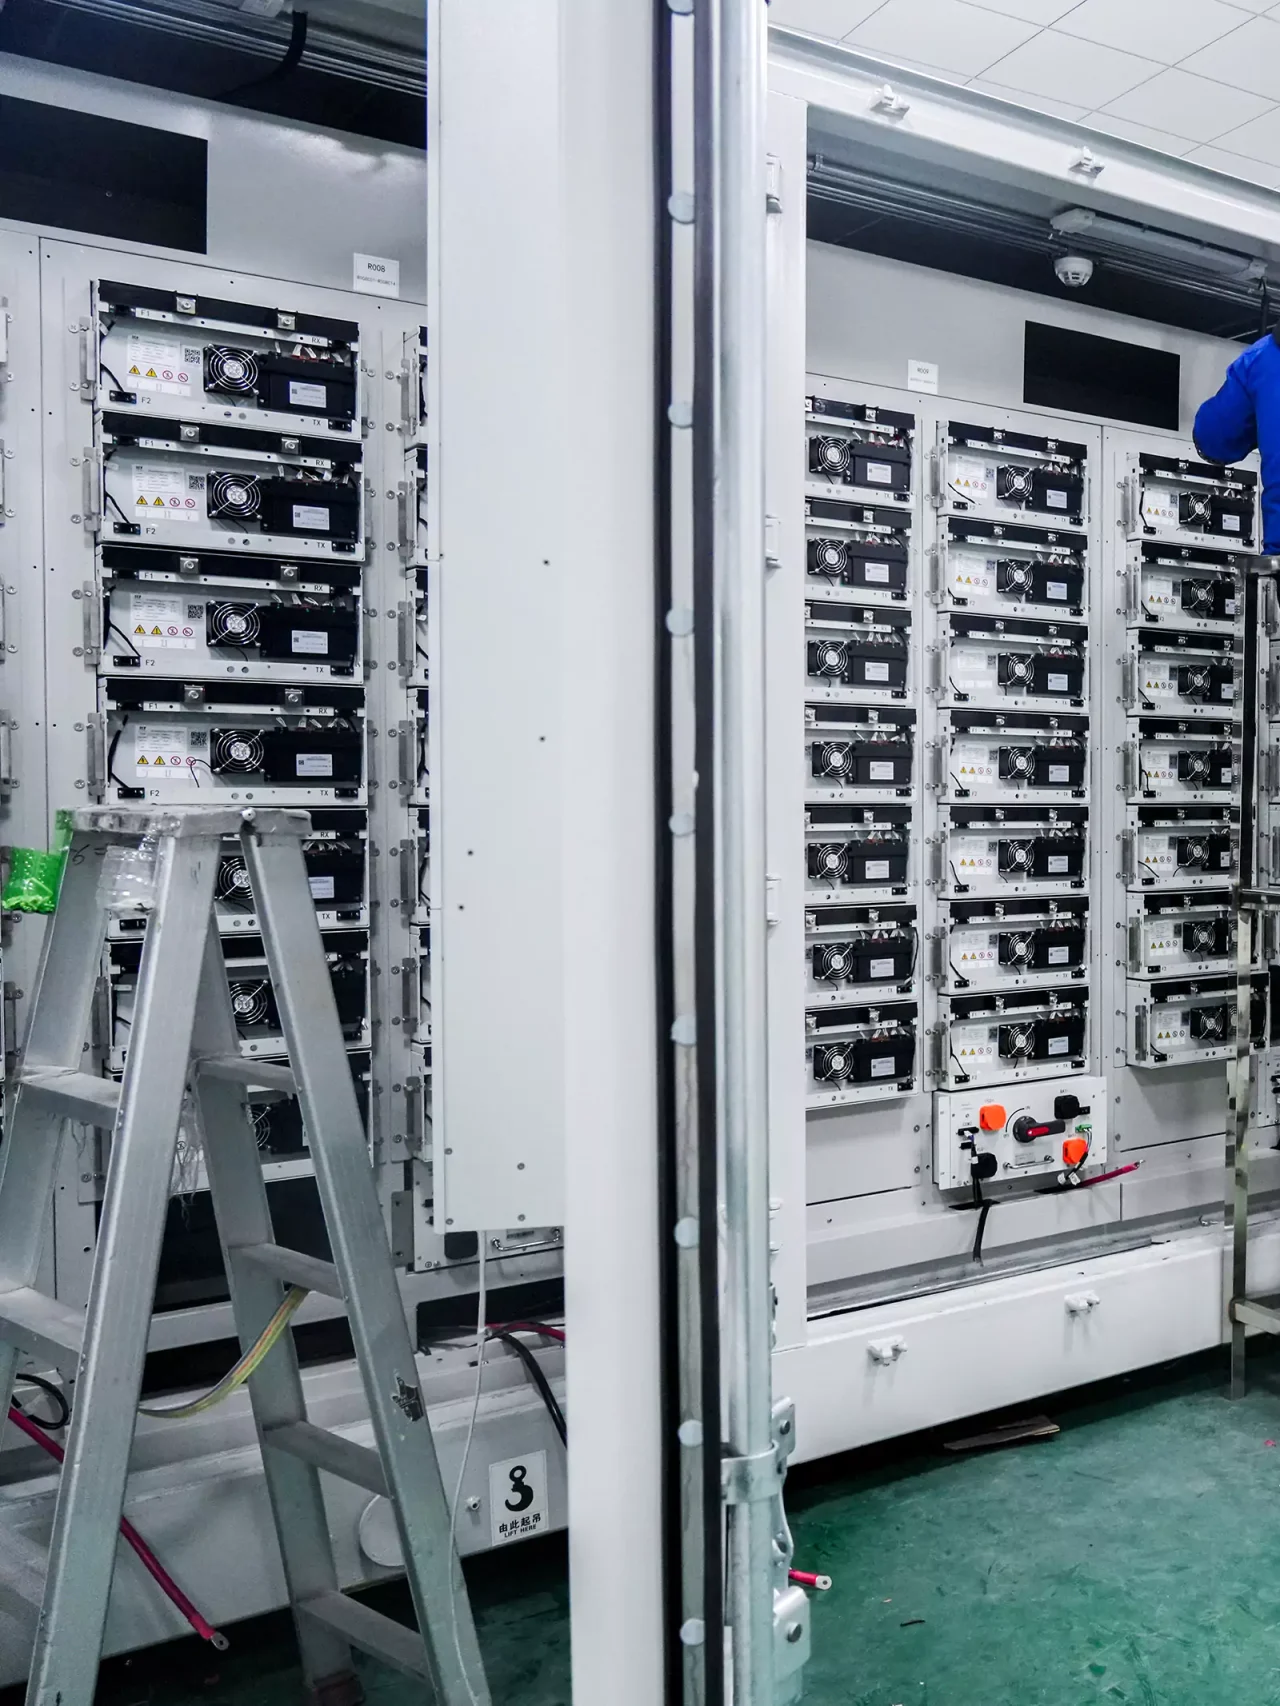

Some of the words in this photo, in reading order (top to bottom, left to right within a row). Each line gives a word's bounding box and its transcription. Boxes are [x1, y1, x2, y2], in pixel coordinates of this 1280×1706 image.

[499, 1512, 541, 1533] 由此起吊
[504, 1530, 517, 1538] LIFT
[520, 1524, 536, 1533] HERE
